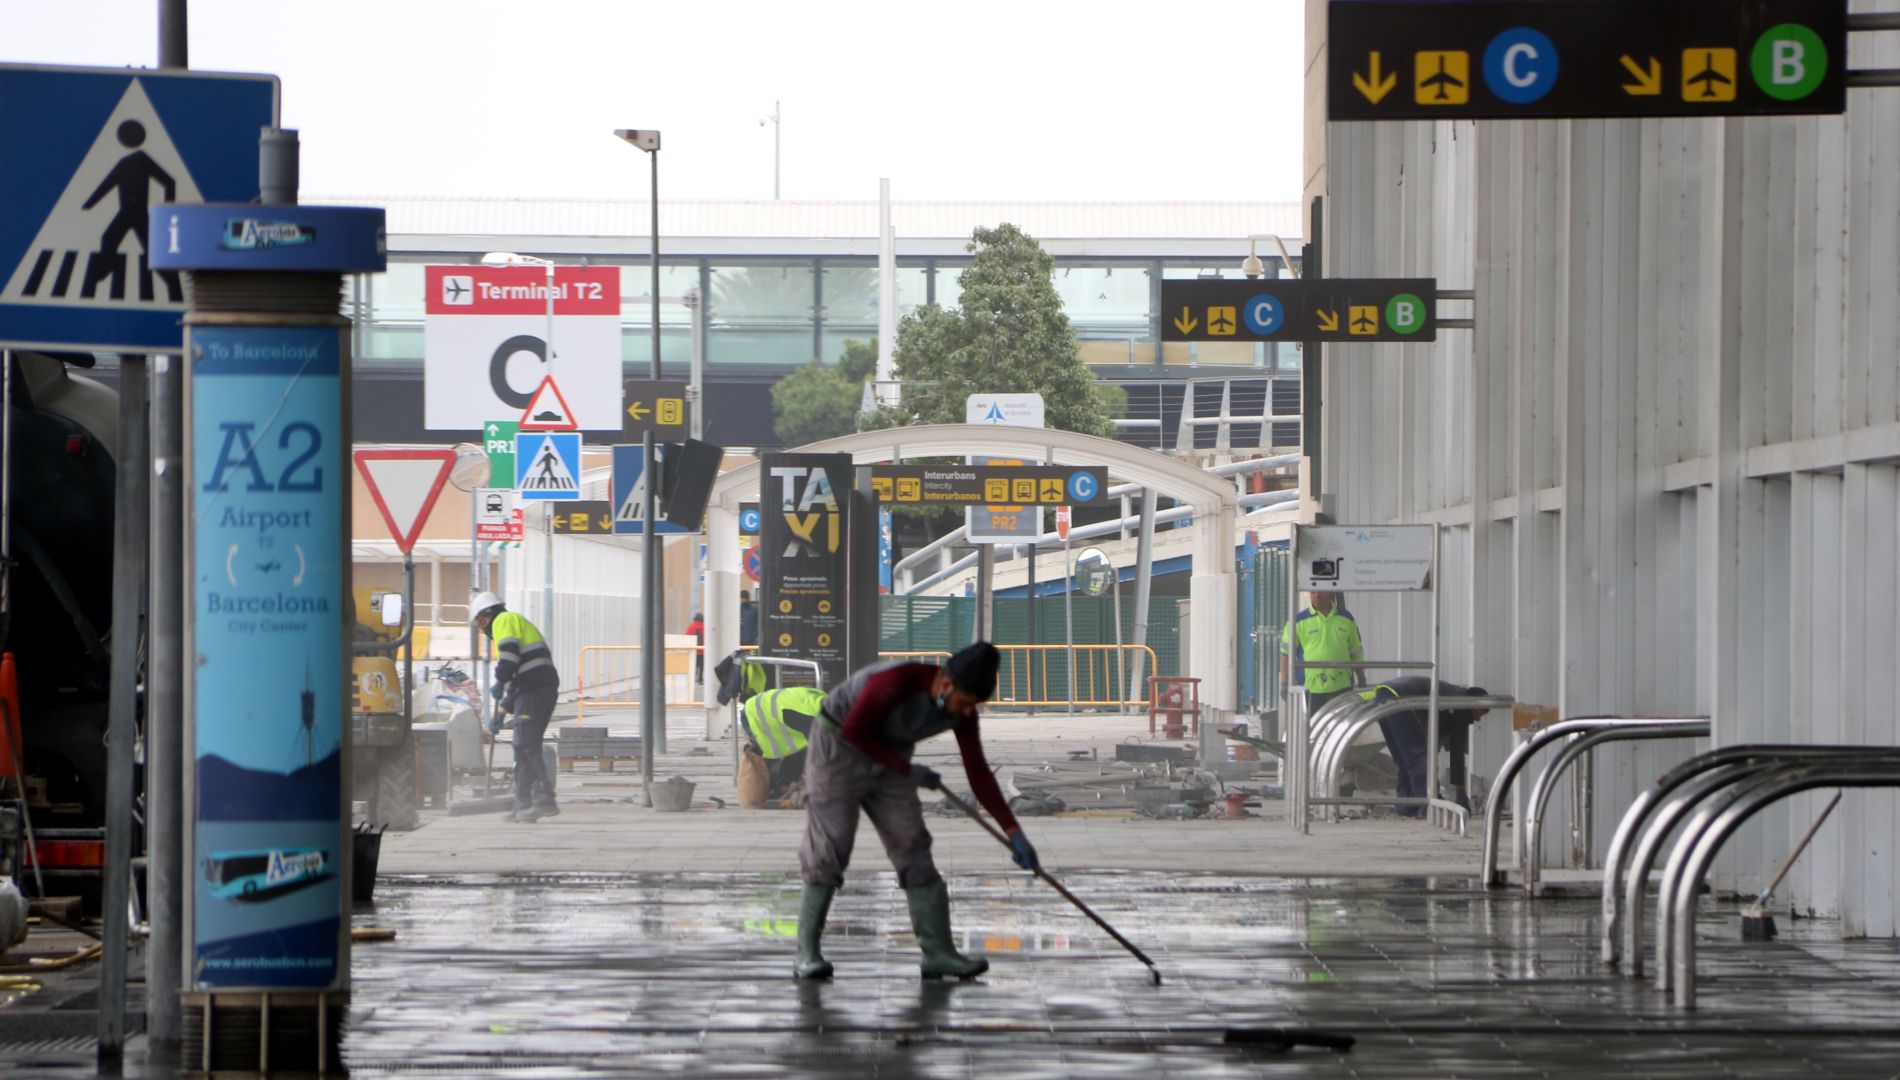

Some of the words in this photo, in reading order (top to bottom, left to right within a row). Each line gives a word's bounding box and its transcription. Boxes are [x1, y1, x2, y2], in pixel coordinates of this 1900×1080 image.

[1502, 43, 1539, 88] C
[1771, 40, 1806, 85] B
[478, 282, 568, 300] Terminal
[574, 282, 603, 300] T2
[1254, 302, 1272, 327] C
[1396, 302, 1415, 327] B
[209, 343, 229, 359] To
[233, 342, 319, 359] Barcelona
[489, 334, 557, 409] C
[202, 421, 324, 493] A2
[924, 471, 977, 480] Interurbans
[924, 481, 953, 491] Intercity
[1076, 477, 1092, 497] C
[924, 492, 981, 501] Interurbanos
[220, 506, 312, 532] Airport
[744, 512, 758, 529] C
[991, 516, 1019, 530] PR2
[206, 593, 330, 614] Barcelona
[227, 620, 256, 635] City
[260, 620, 308, 633] Center
